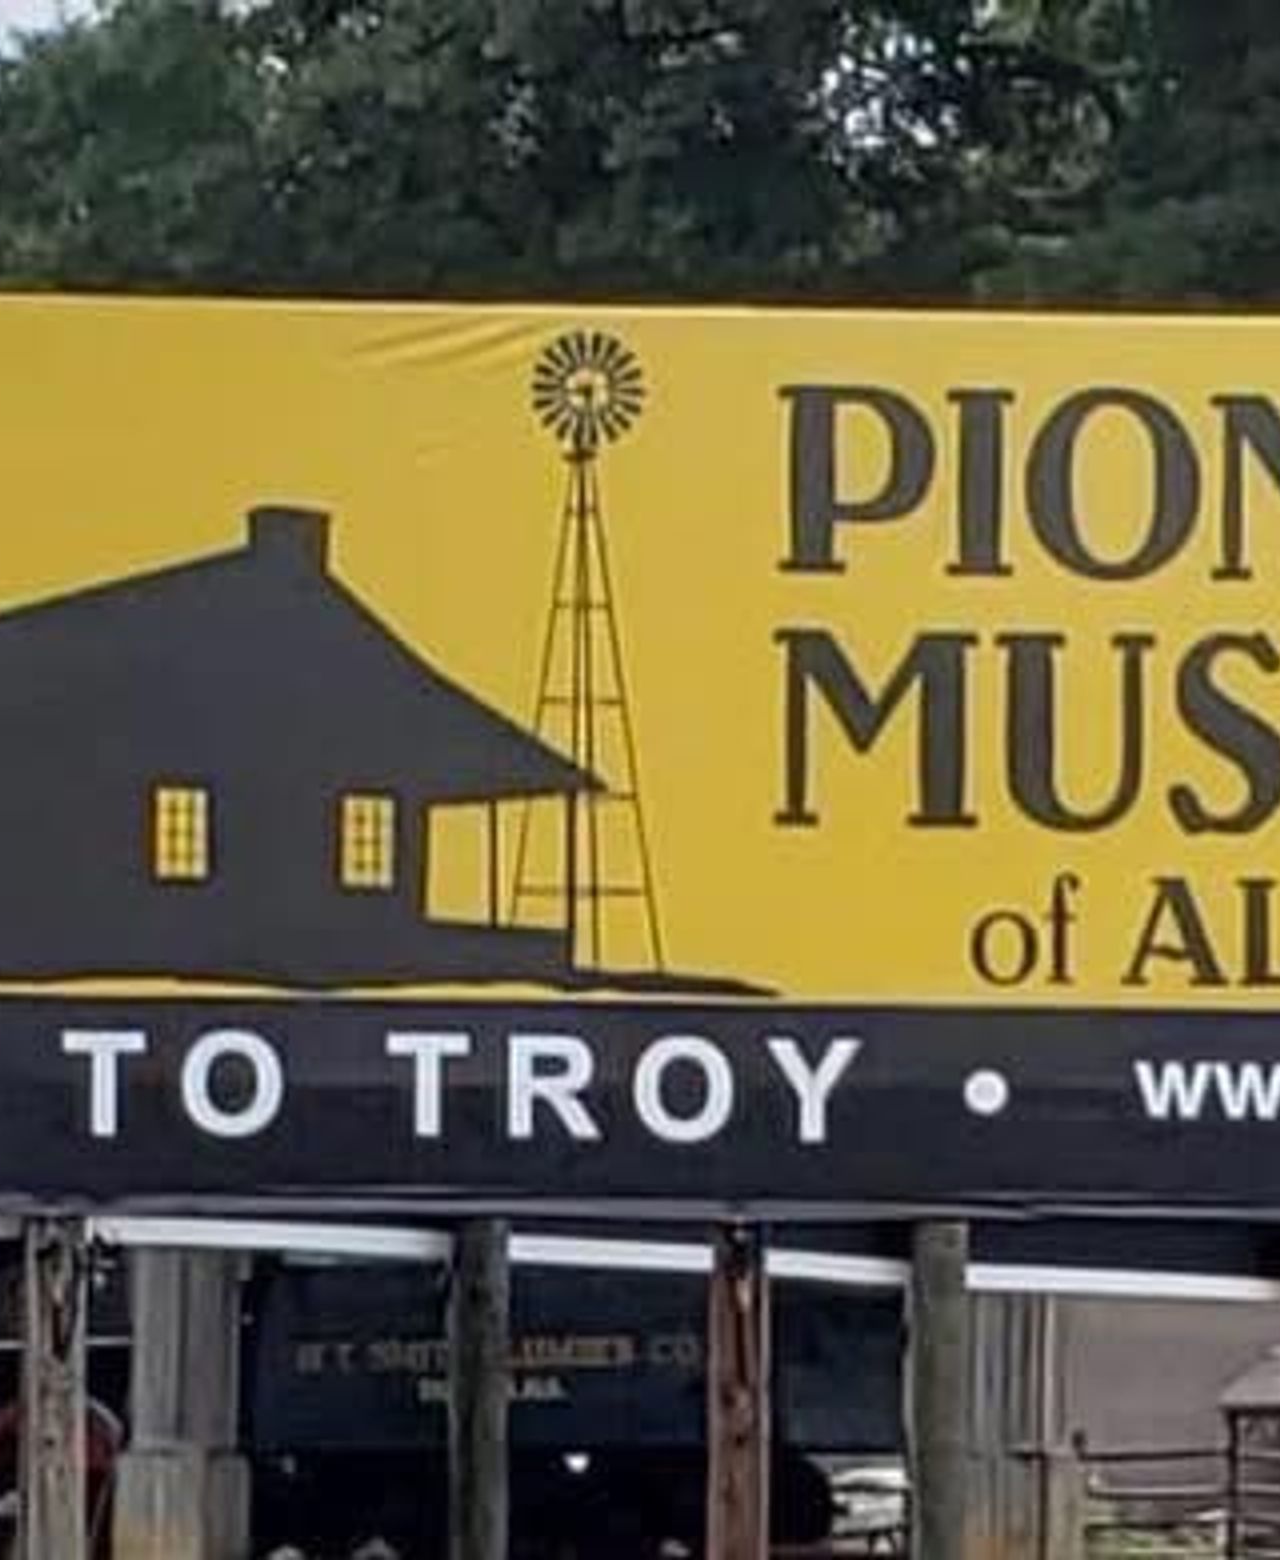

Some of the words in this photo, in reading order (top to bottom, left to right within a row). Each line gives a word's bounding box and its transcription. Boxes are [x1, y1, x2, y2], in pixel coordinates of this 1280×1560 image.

[969, 873, 1081, 985] of
[62, 1030, 283, 1137] TO
[386, 1032, 861, 1143] TROY
